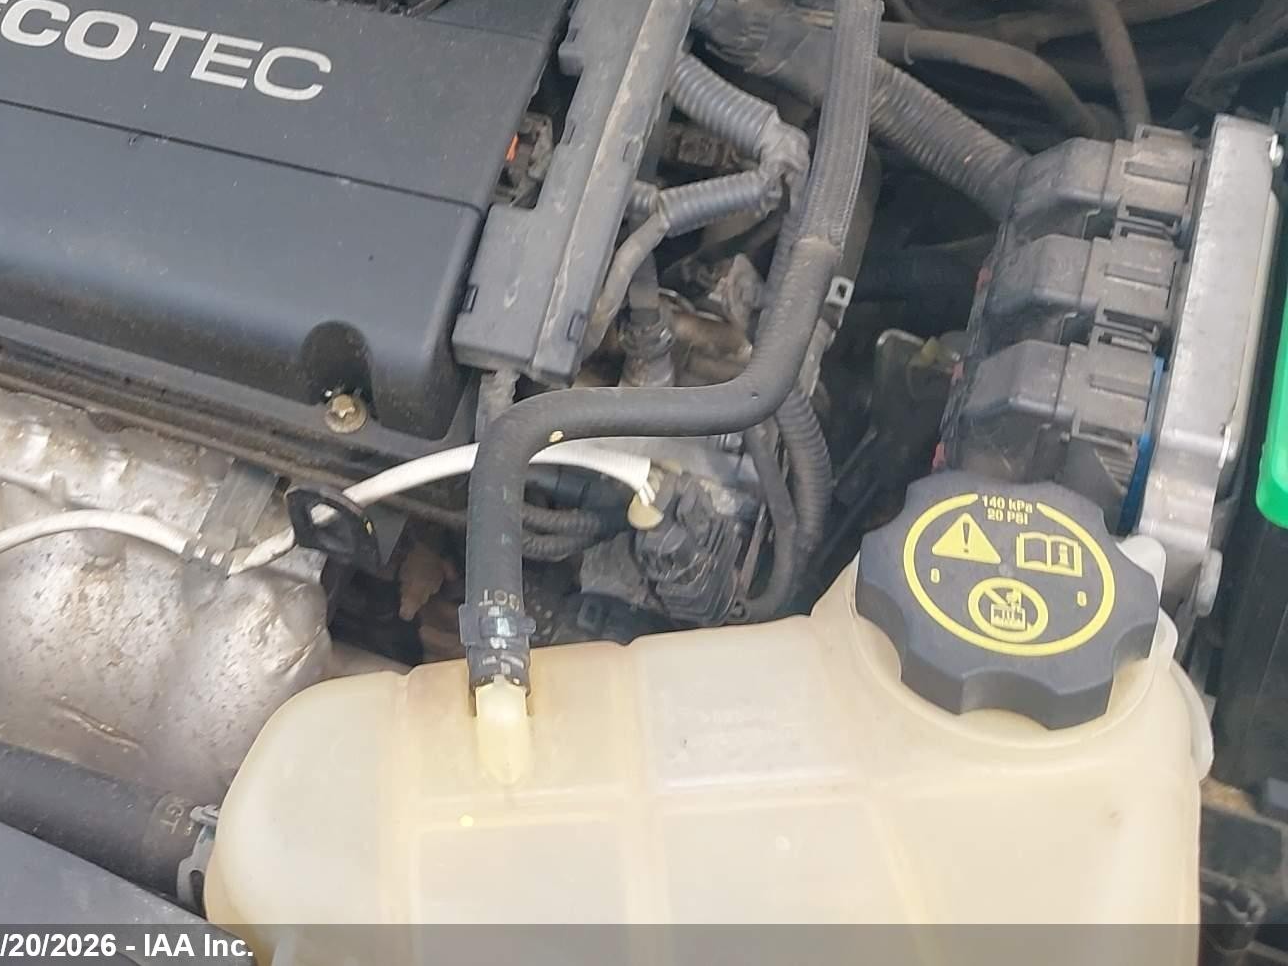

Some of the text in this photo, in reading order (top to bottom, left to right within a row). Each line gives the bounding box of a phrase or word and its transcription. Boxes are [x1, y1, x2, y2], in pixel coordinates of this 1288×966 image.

[981, 495, 1033, 514] 140 kPa
[987, 507, 1004, 522] 20
